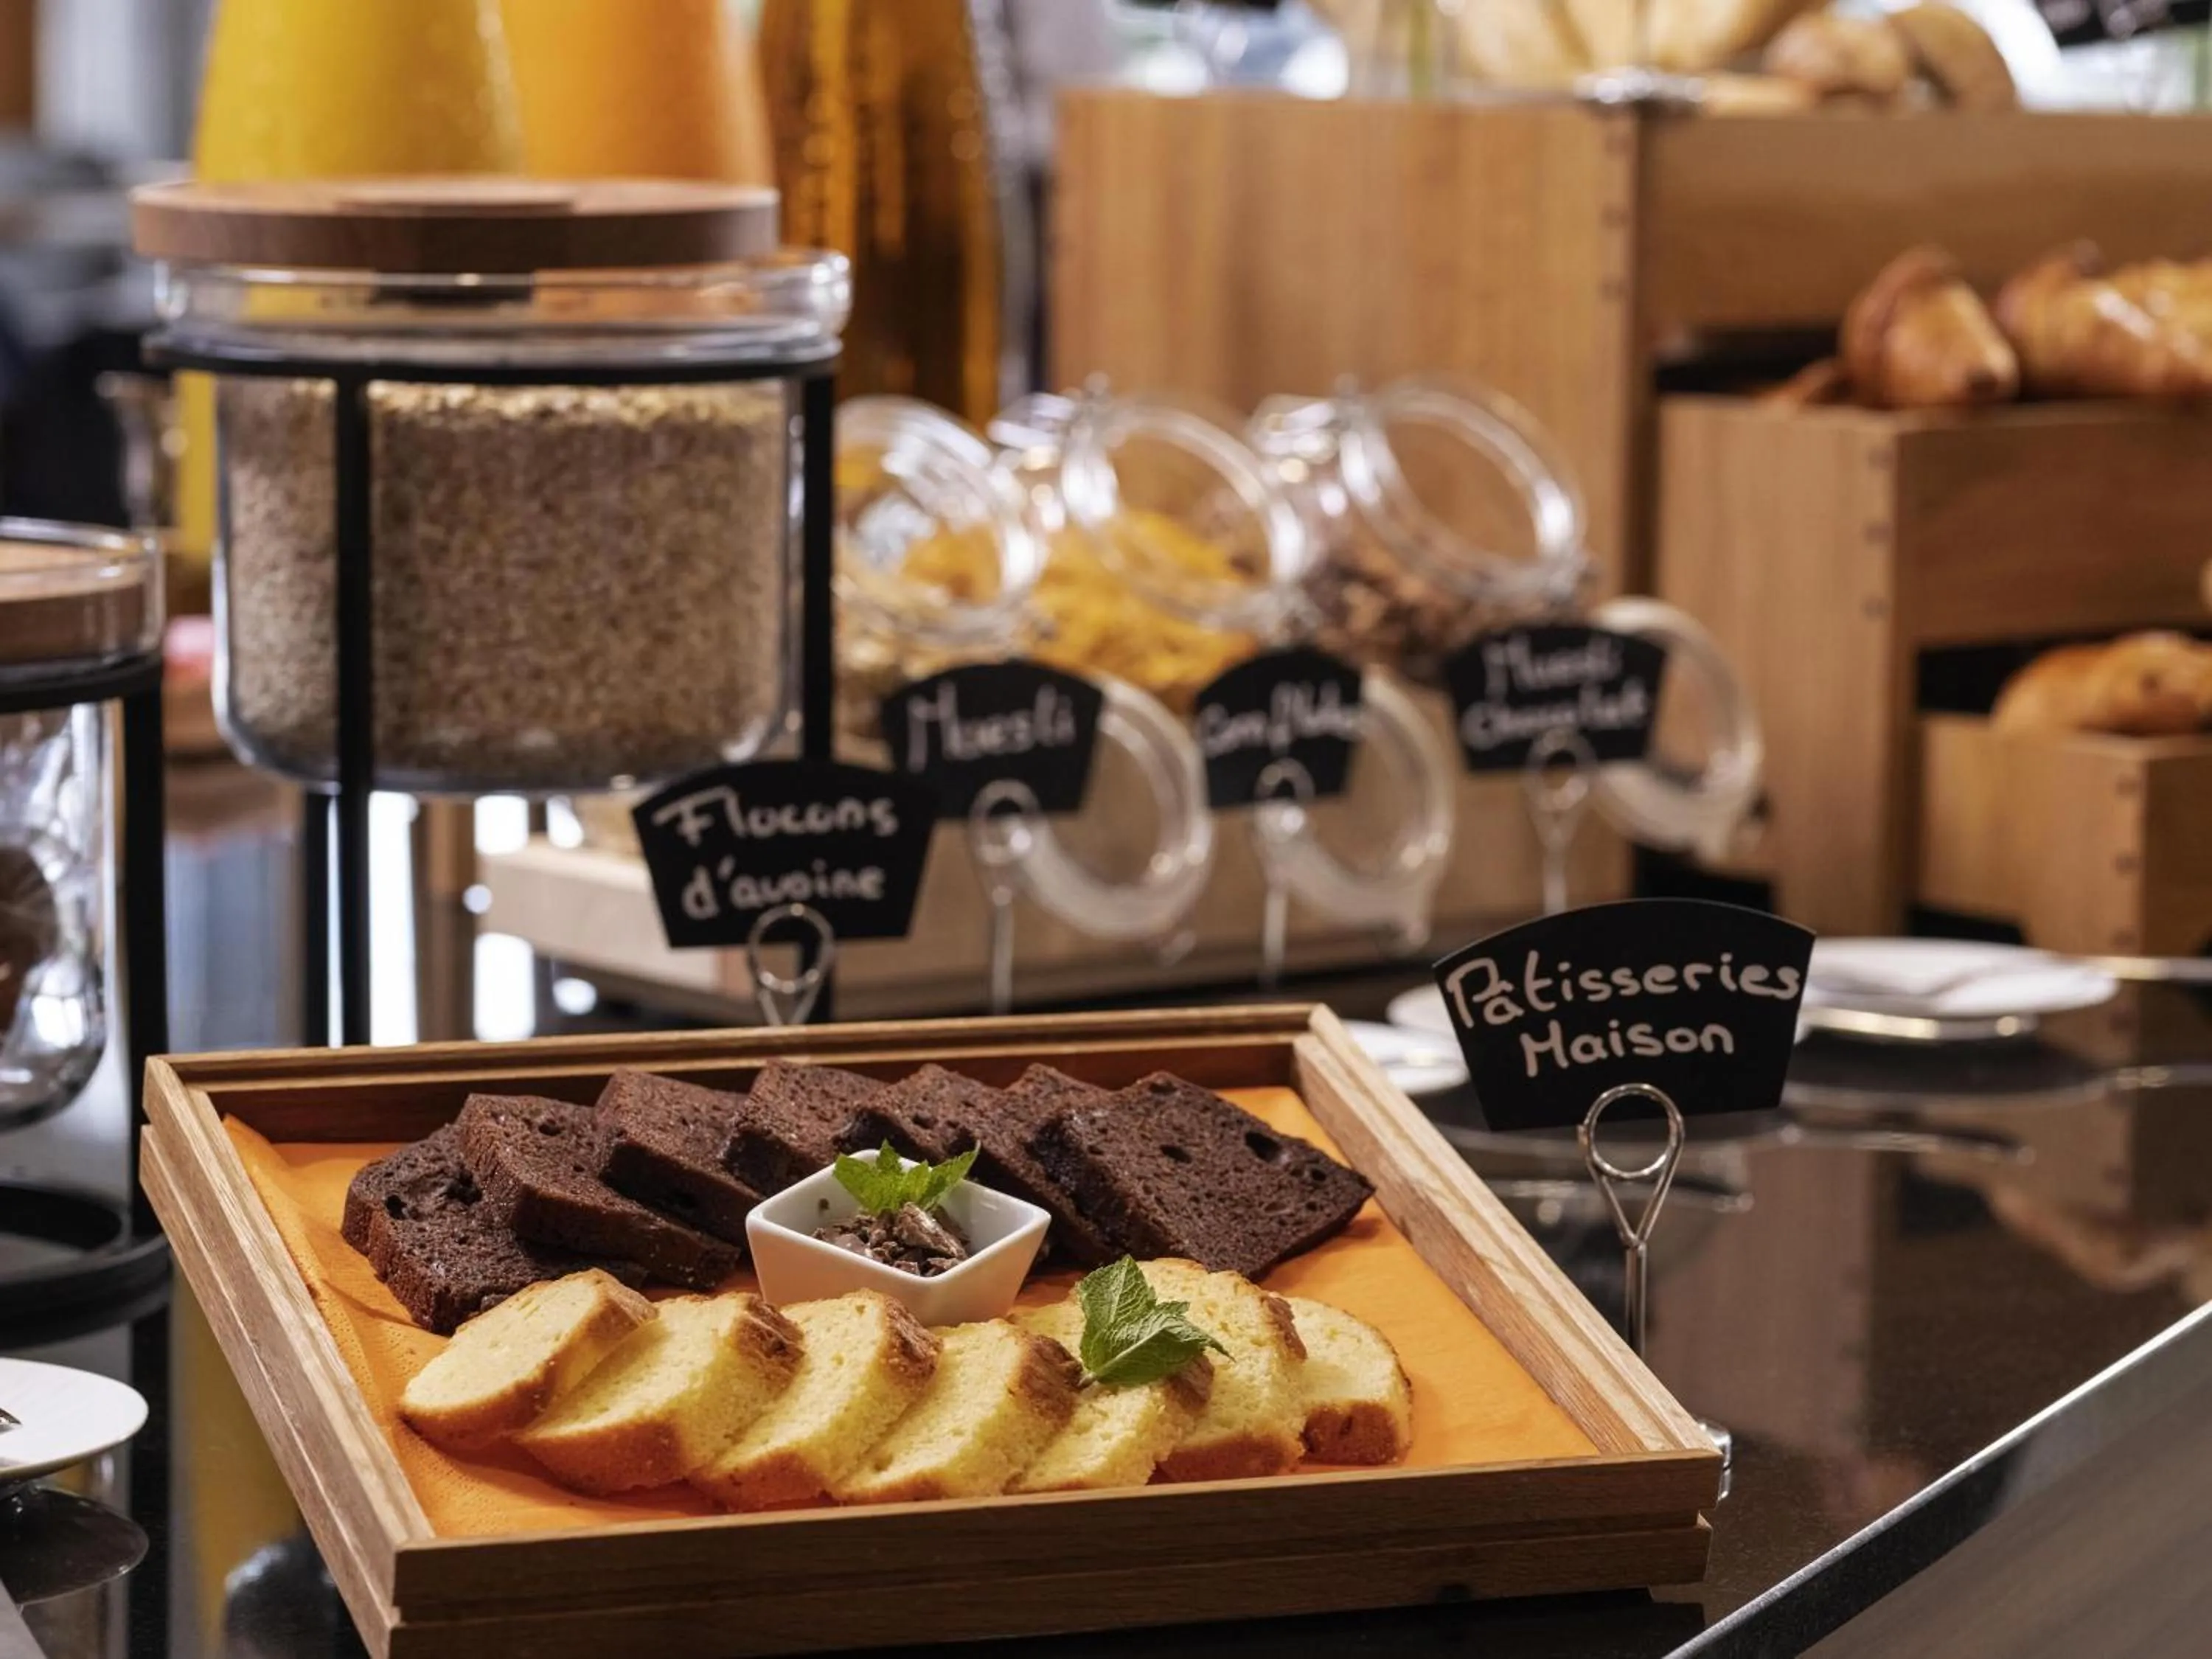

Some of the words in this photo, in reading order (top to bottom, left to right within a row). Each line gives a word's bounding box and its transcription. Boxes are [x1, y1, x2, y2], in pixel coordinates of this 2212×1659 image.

[907, 681, 1076, 772] Muesli
[653, 786, 899, 846] Flocons
[682, 855, 885, 919] d'avoine
[1521, 1019, 1734, 1077] Maison
